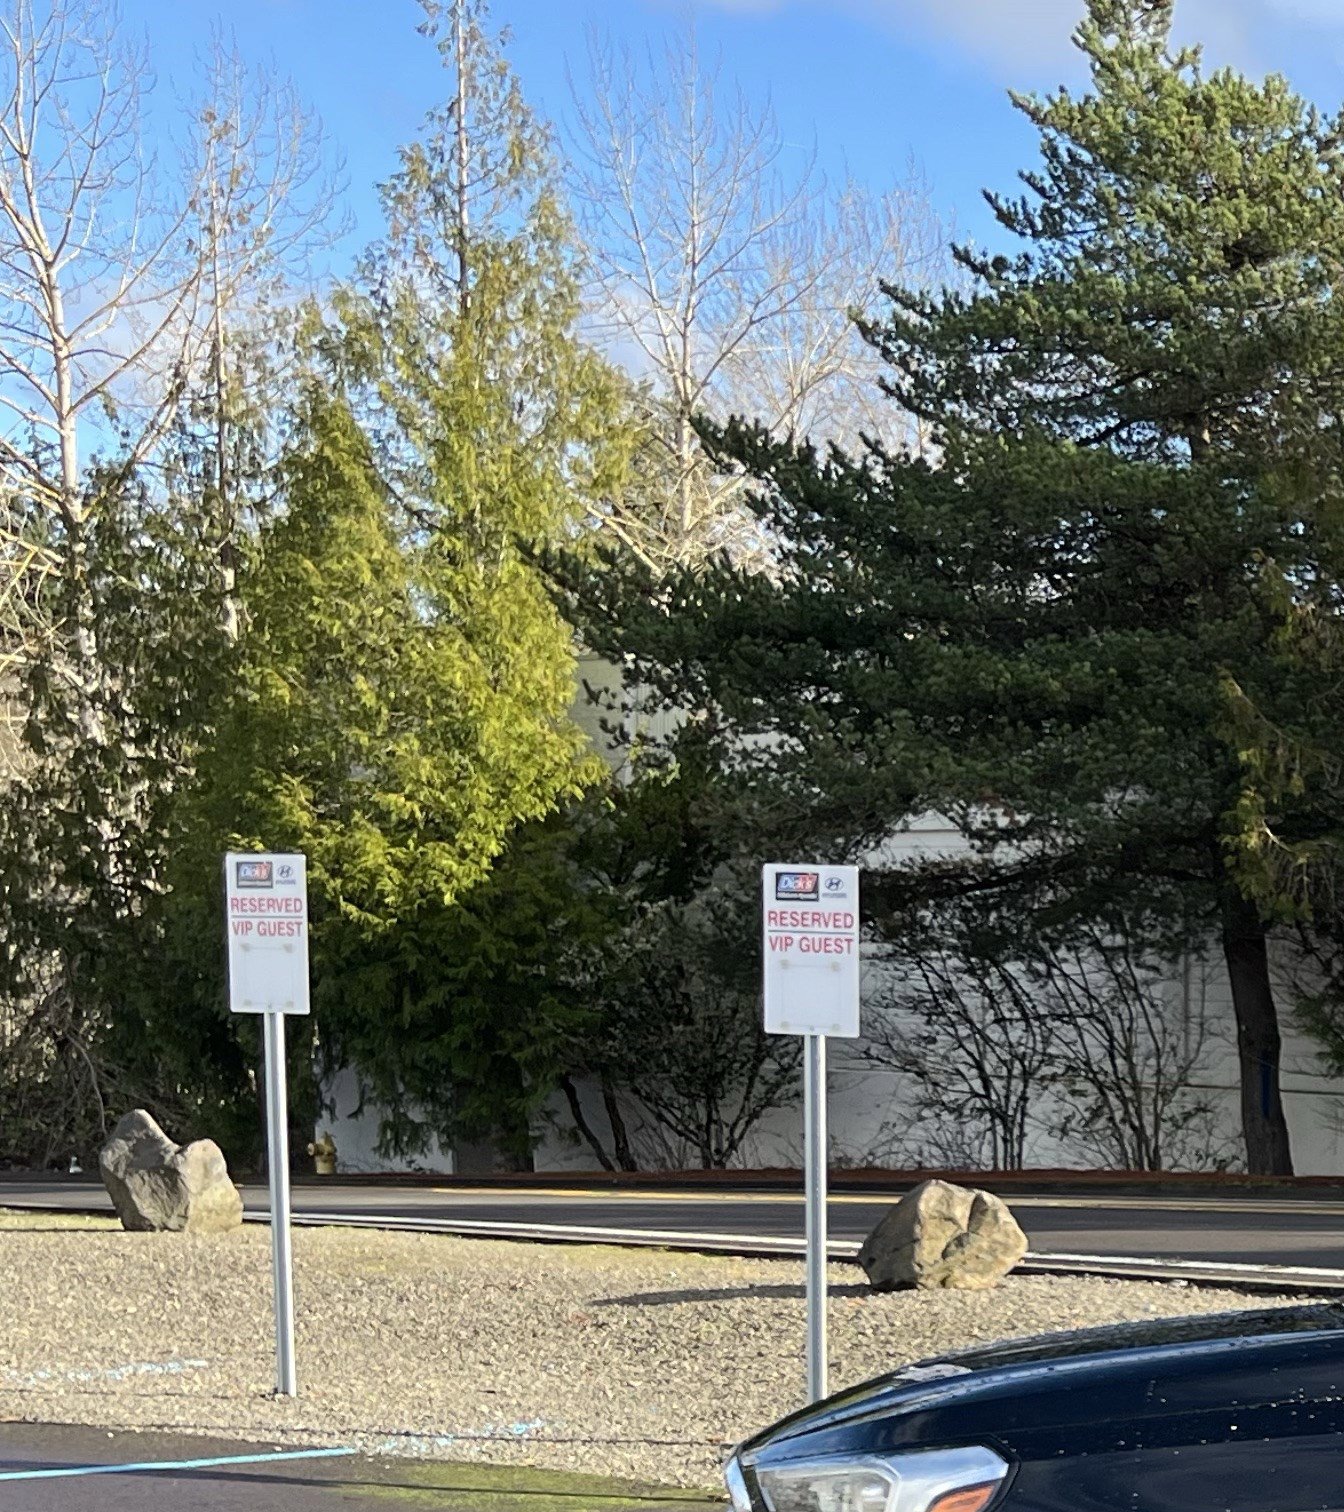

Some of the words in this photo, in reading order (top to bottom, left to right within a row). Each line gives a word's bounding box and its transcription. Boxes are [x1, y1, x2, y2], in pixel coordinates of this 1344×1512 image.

[231, 897, 303, 914] RESERVED
[768, 910, 855, 929] RESERVED
[232, 921, 253, 937] VIP
[257, 921, 303, 938] GUEST
[769, 936, 794, 953] VIP
[799, 936, 854, 955] GUEST
